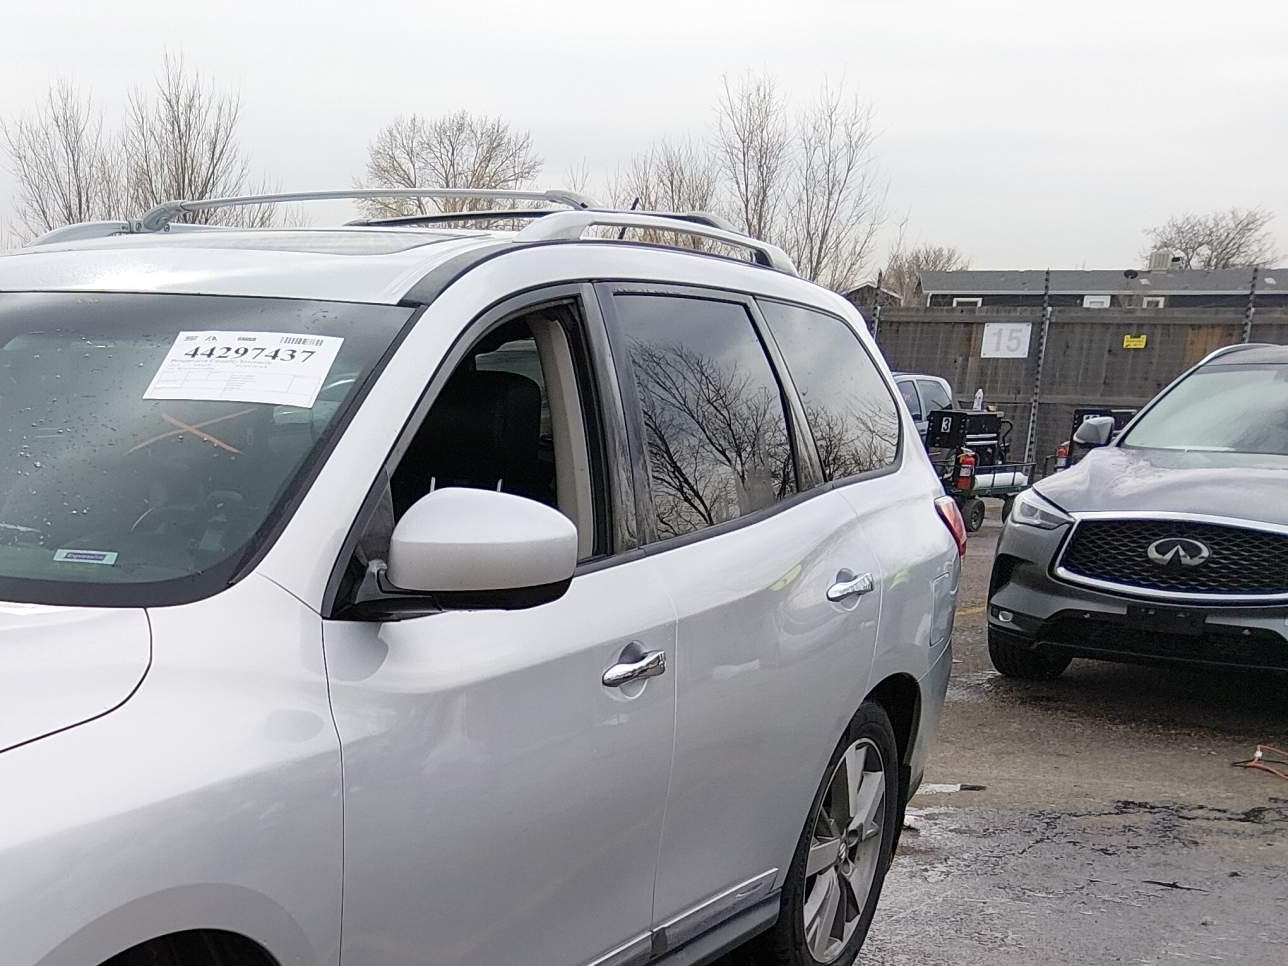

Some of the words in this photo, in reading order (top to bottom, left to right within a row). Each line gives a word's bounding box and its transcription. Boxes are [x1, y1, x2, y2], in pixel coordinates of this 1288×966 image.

[992, 327, 1024, 353] 15
[185, 346, 315, 363] 44297437
[942, 417, 951, 432] 3
